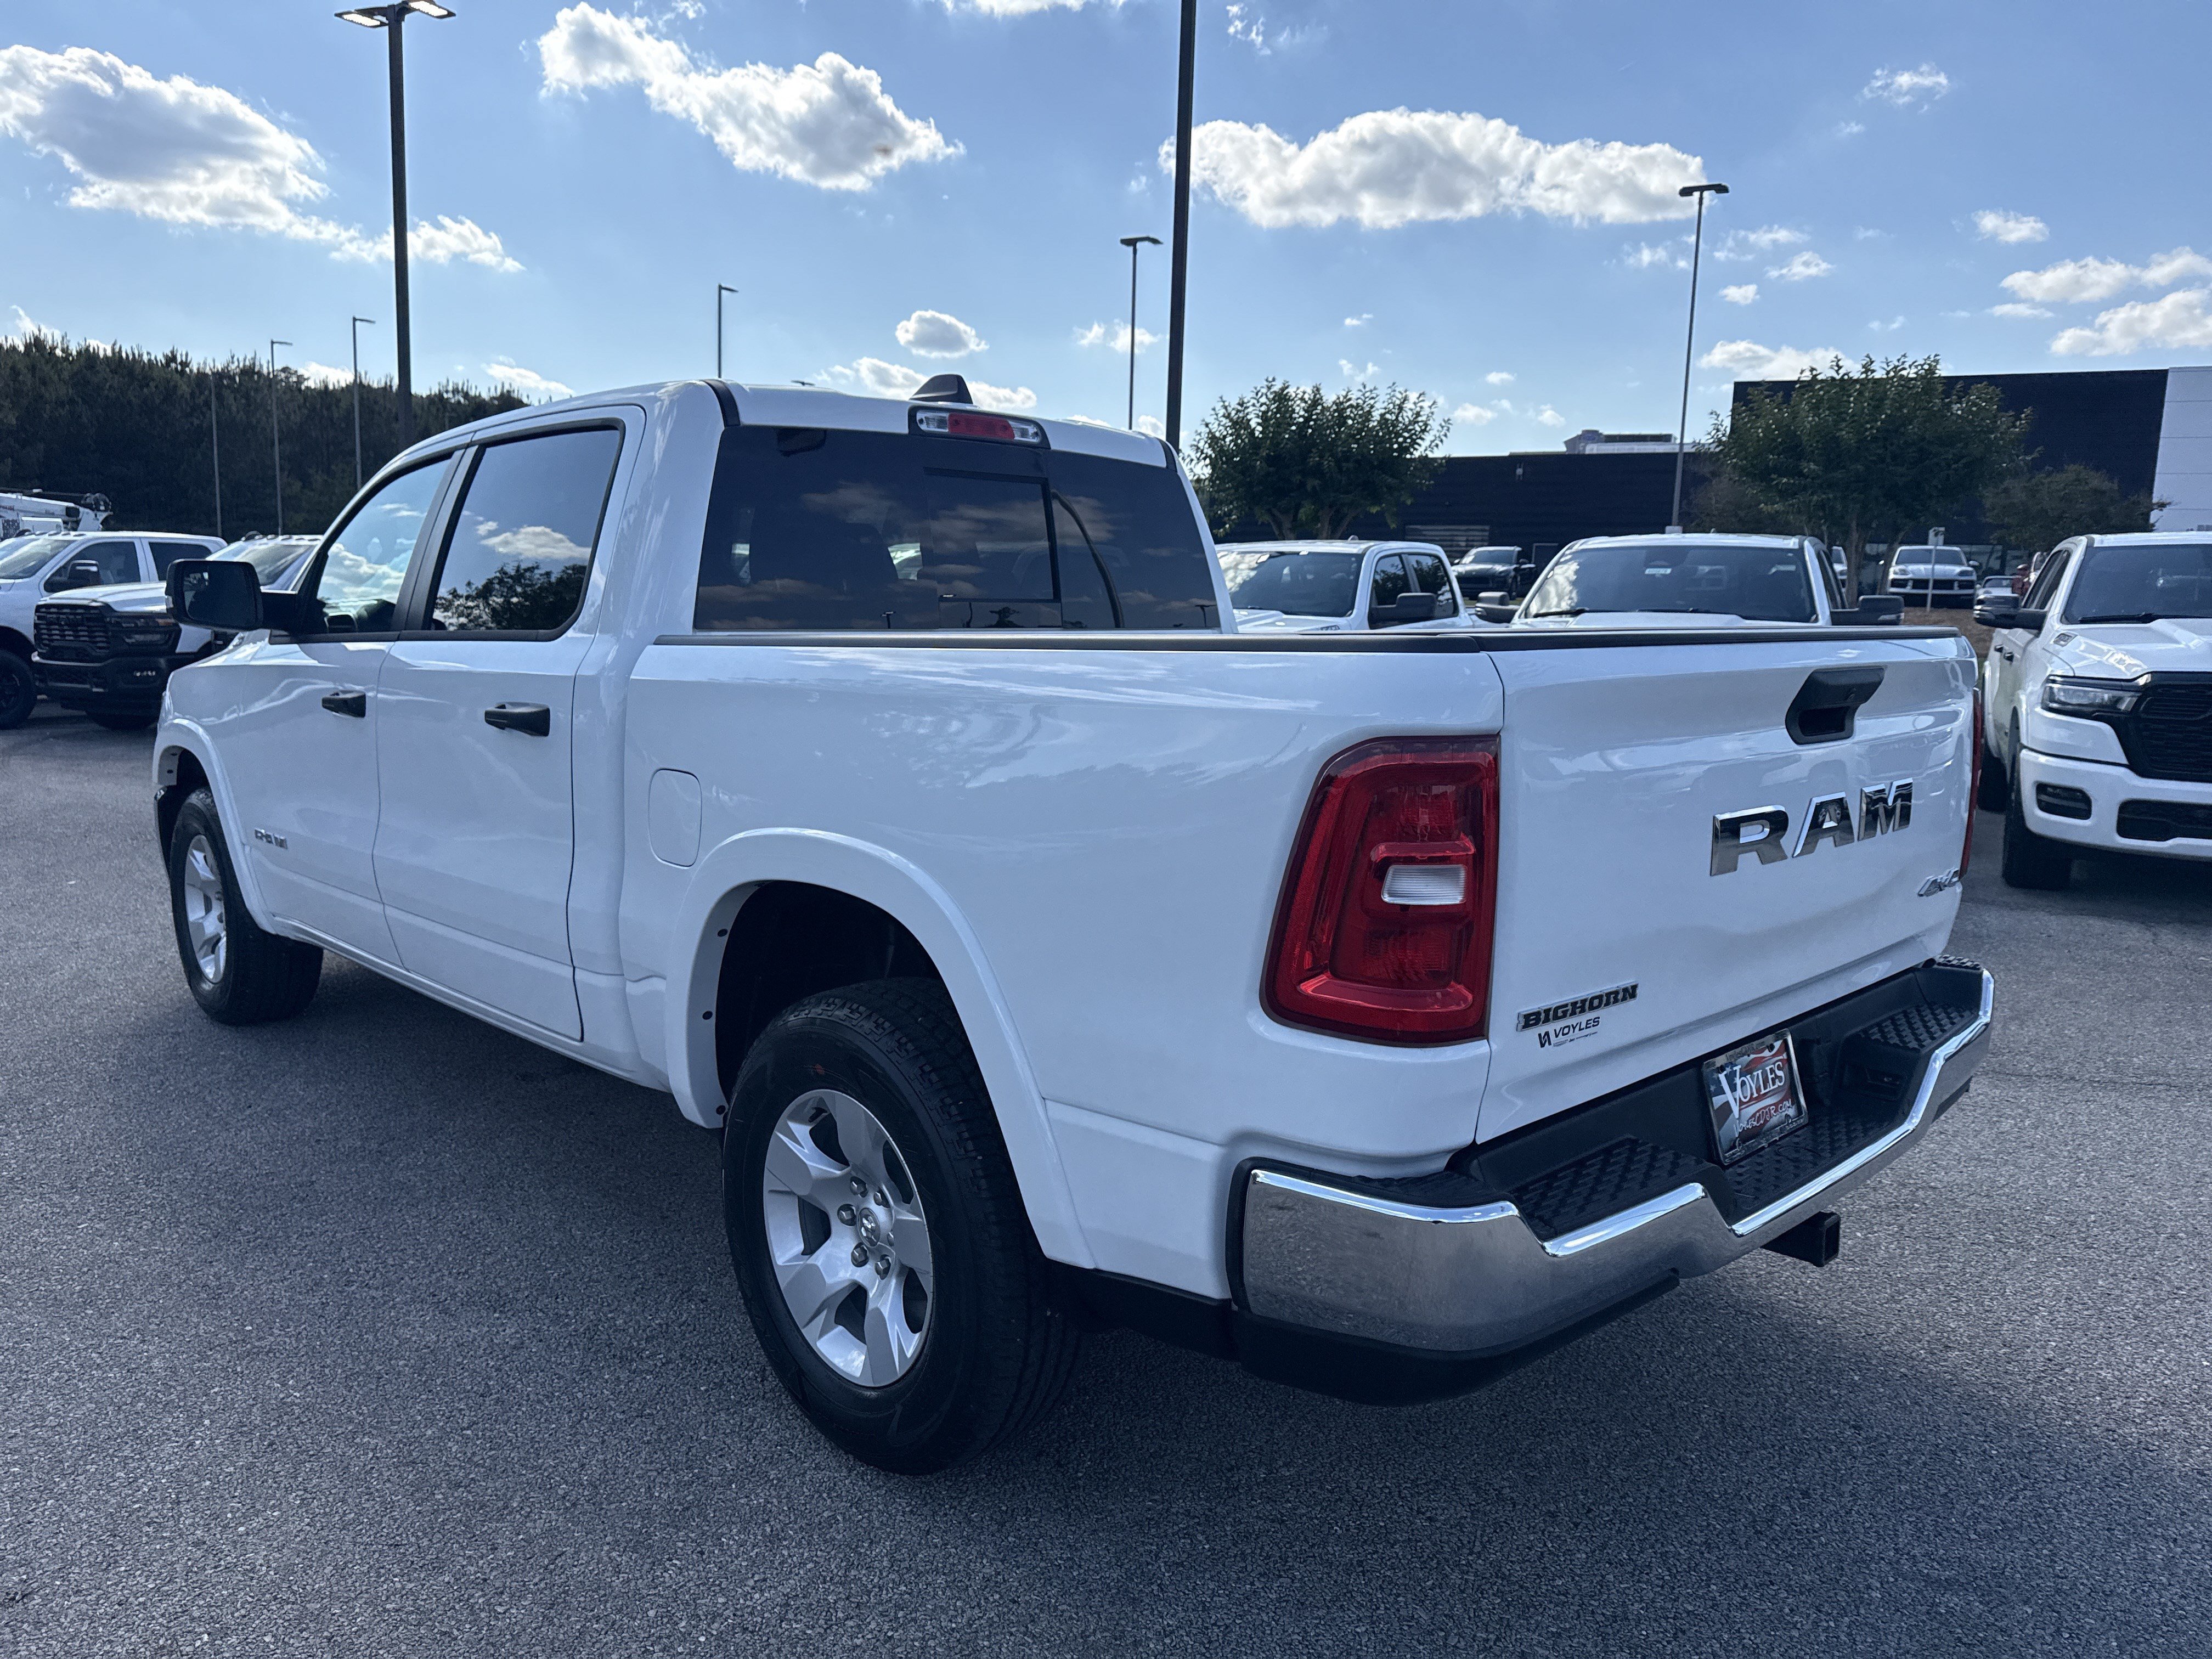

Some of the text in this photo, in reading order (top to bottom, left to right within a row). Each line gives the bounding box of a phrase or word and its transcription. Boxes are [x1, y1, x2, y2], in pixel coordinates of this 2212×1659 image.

[1710, 777, 1913, 876] RAM
[1519, 983, 1639, 1031] BIGHORN
[1554, 1017, 1600, 1038] VOYLES
[1718, 1062, 1785, 1118] VOYLES
